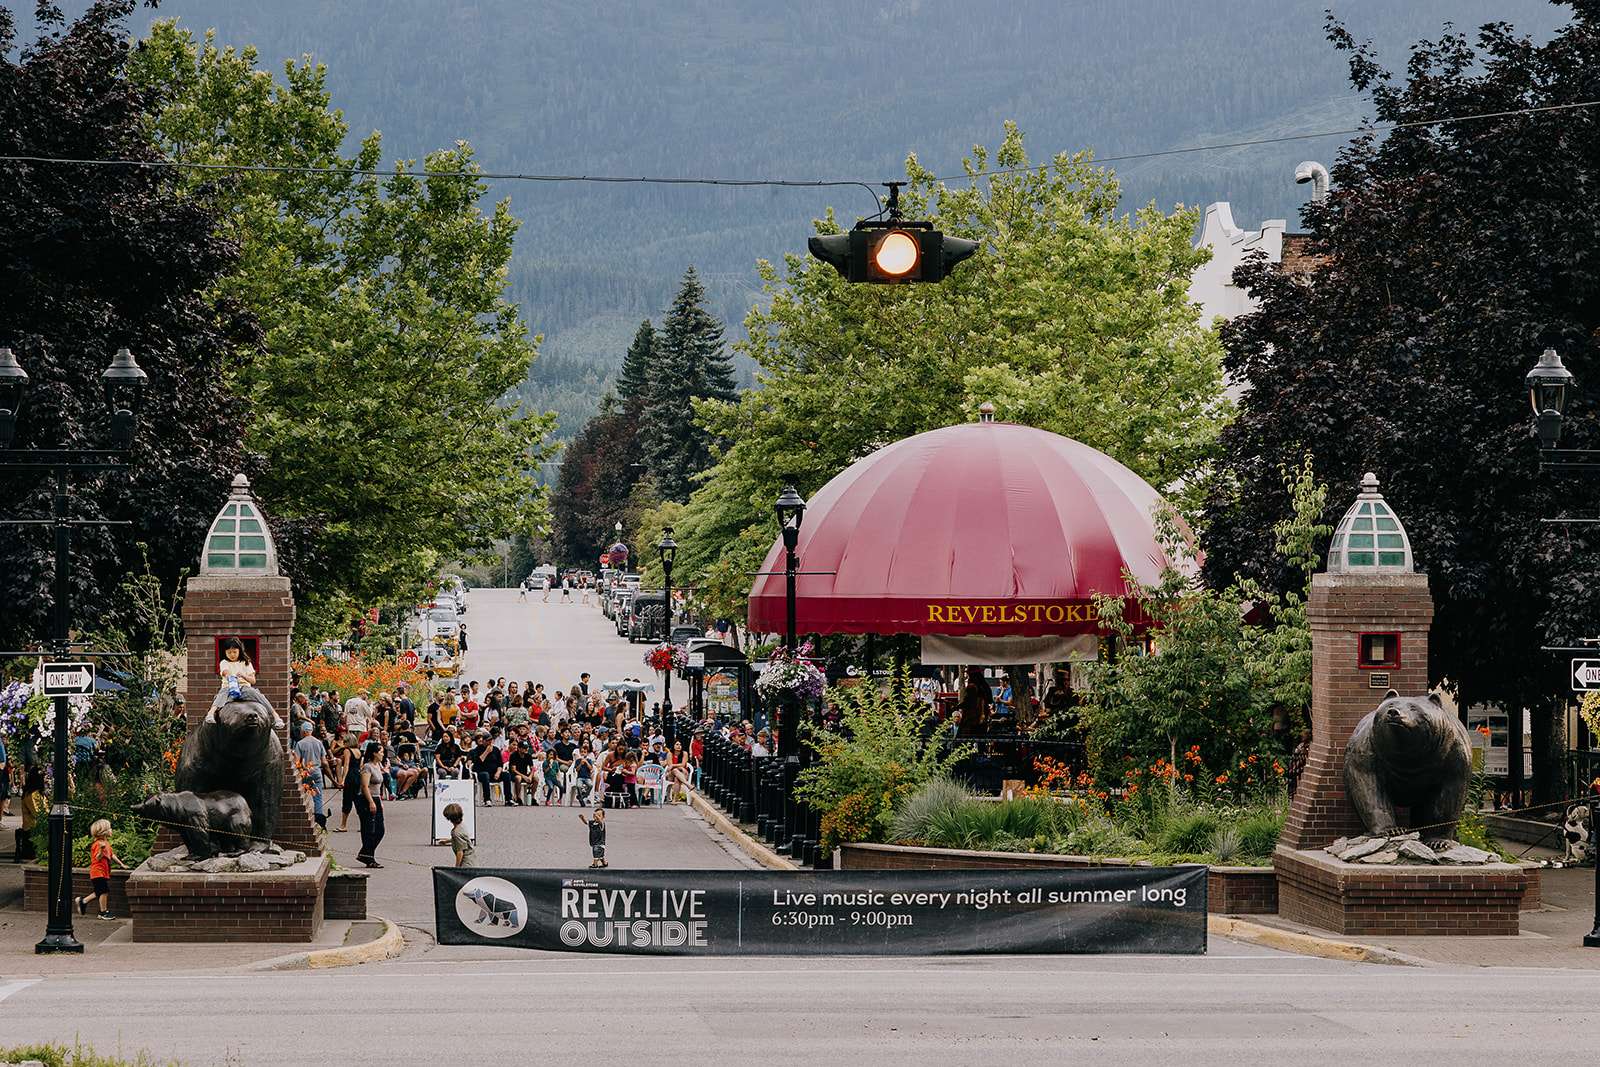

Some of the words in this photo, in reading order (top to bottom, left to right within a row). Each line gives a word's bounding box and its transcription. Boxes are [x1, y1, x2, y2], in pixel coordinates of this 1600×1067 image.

[927, 604, 1099, 623] REVELSTOKE
[398, 656, 417, 665] STOP
[50, 673, 64, 686] ONE
[67, 673, 83, 686] WAY
[561, 888, 706, 918] REVY.LIVE
[773, 889, 817, 906] Live
[822, 889, 884, 906] music
[890, 892, 951, 909] every
[956, 888, 1011, 910] night
[1017, 888, 1042, 904] all
[1048, 889, 1136, 903] summer
[1142, 885, 1187, 907] long
[771, 911, 834, 928] 6:30pm
[850, 911, 913, 928] 9:00pm
[559, 920, 708, 947] OUTSIDE
